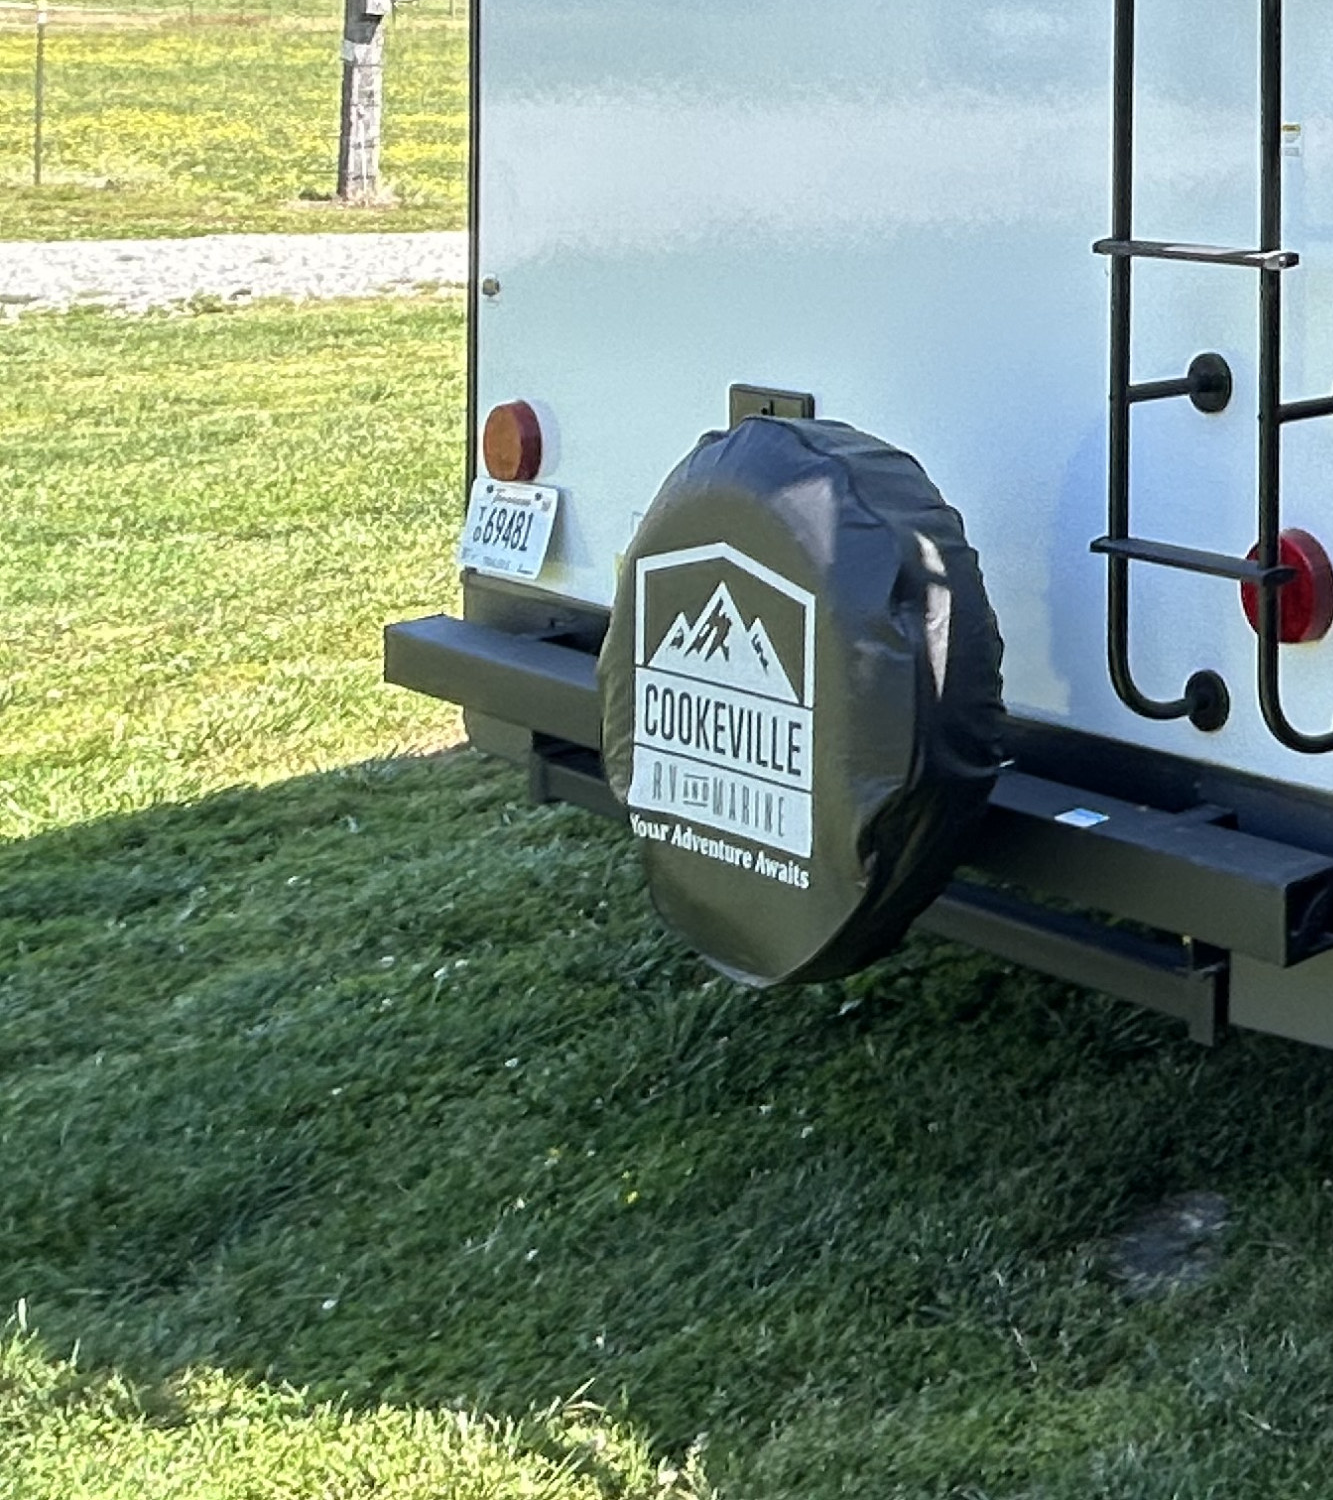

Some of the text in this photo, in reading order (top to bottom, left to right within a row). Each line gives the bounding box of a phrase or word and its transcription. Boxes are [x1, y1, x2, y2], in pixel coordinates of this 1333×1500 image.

[483, 507, 533, 551] 69481
[644, 683, 802, 776] COOKEVILLE
[652, 761, 677, 803] RV
[712, 776, 785, 838] MARINE
[630, 812, 810, 889] Your Adventure Awaits
